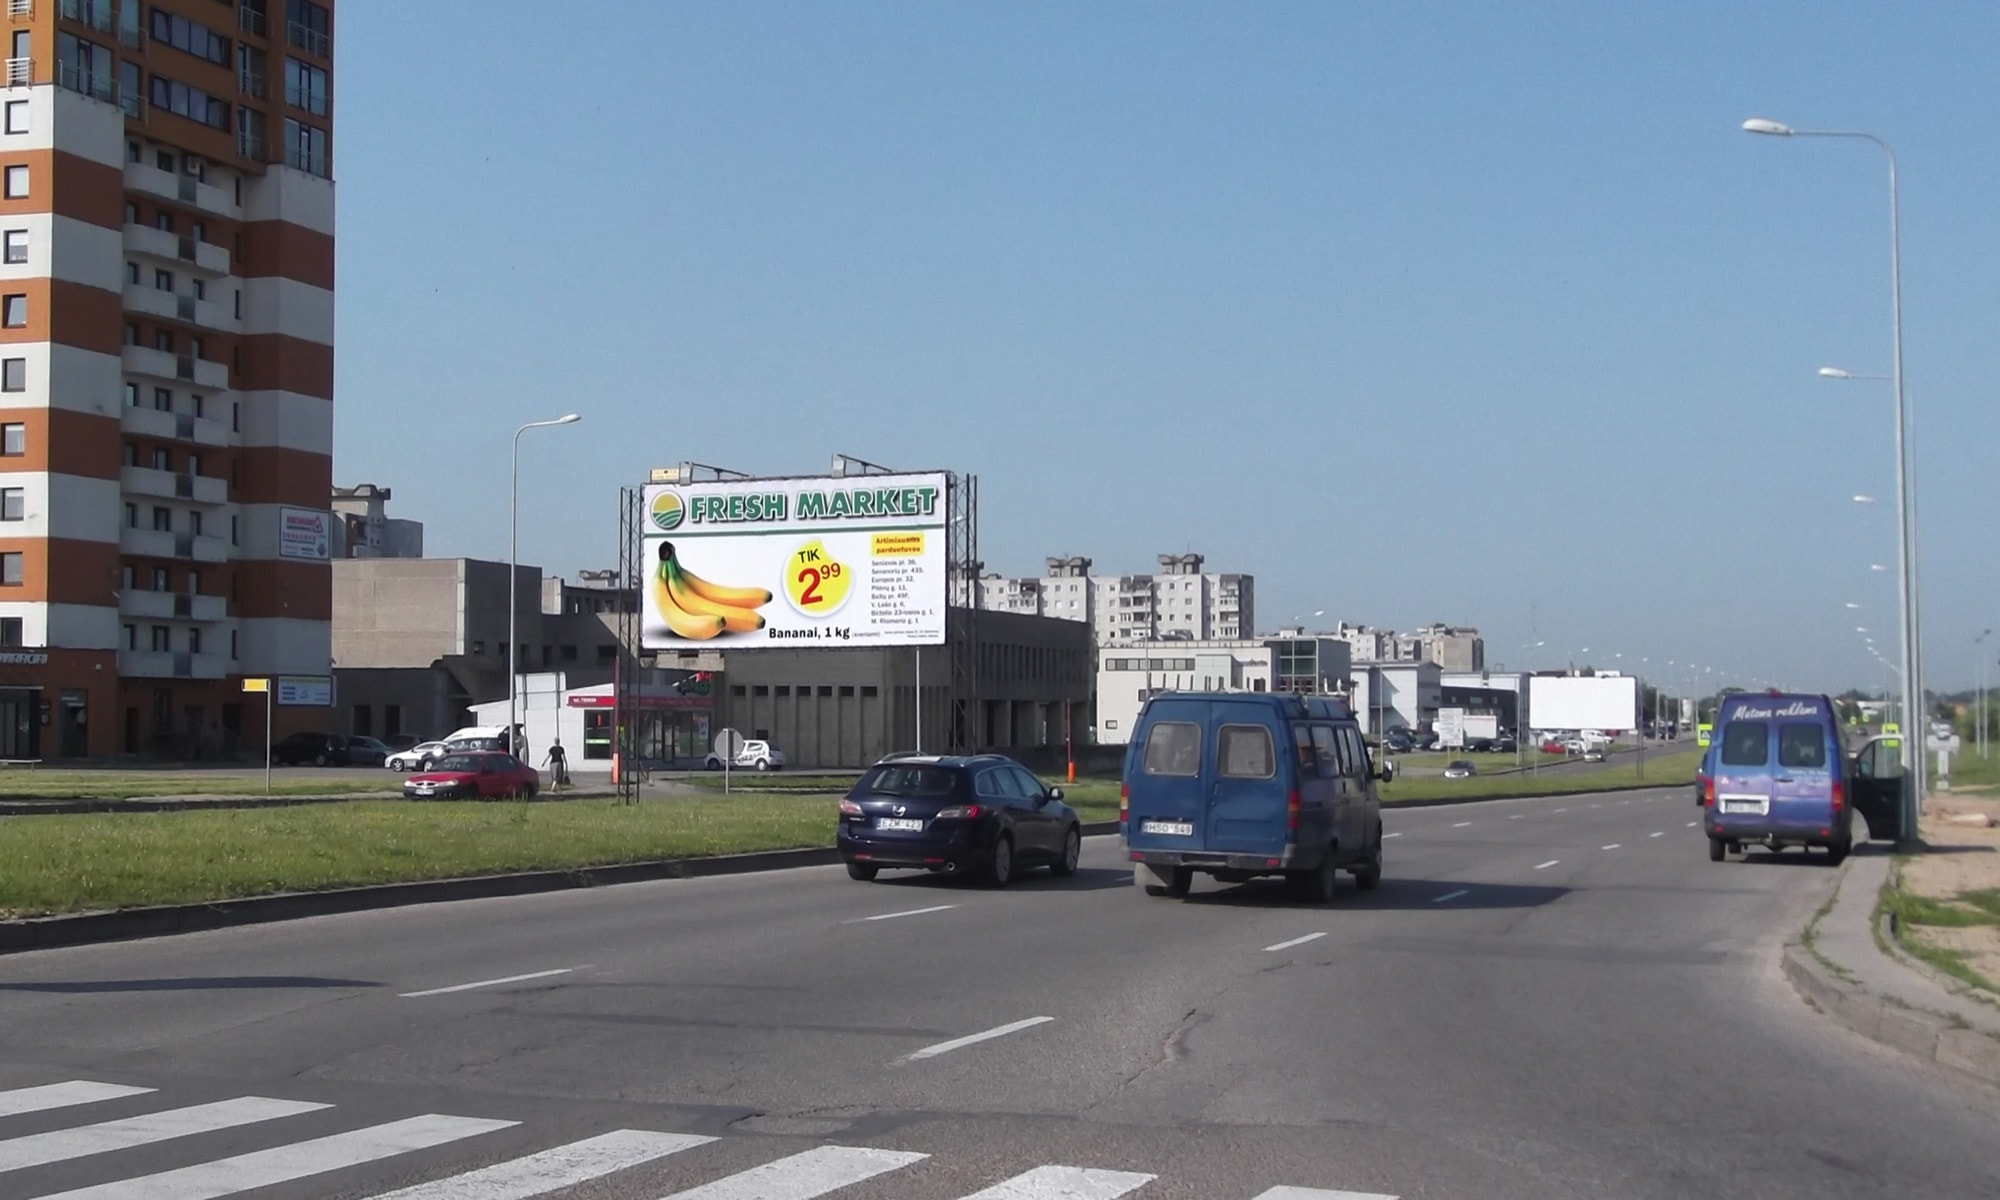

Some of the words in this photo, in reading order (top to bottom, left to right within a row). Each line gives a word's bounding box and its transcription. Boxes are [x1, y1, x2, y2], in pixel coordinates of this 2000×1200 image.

[690, 492, 786, 523] FRESH
[795, 487, 938, 519] MARKET
[798, 548, 820, 564] TIK
[769, 627, 821, 640] Bananai,
[825, 627, 832, 638] 1
[835, 626, 851, 640] kg
